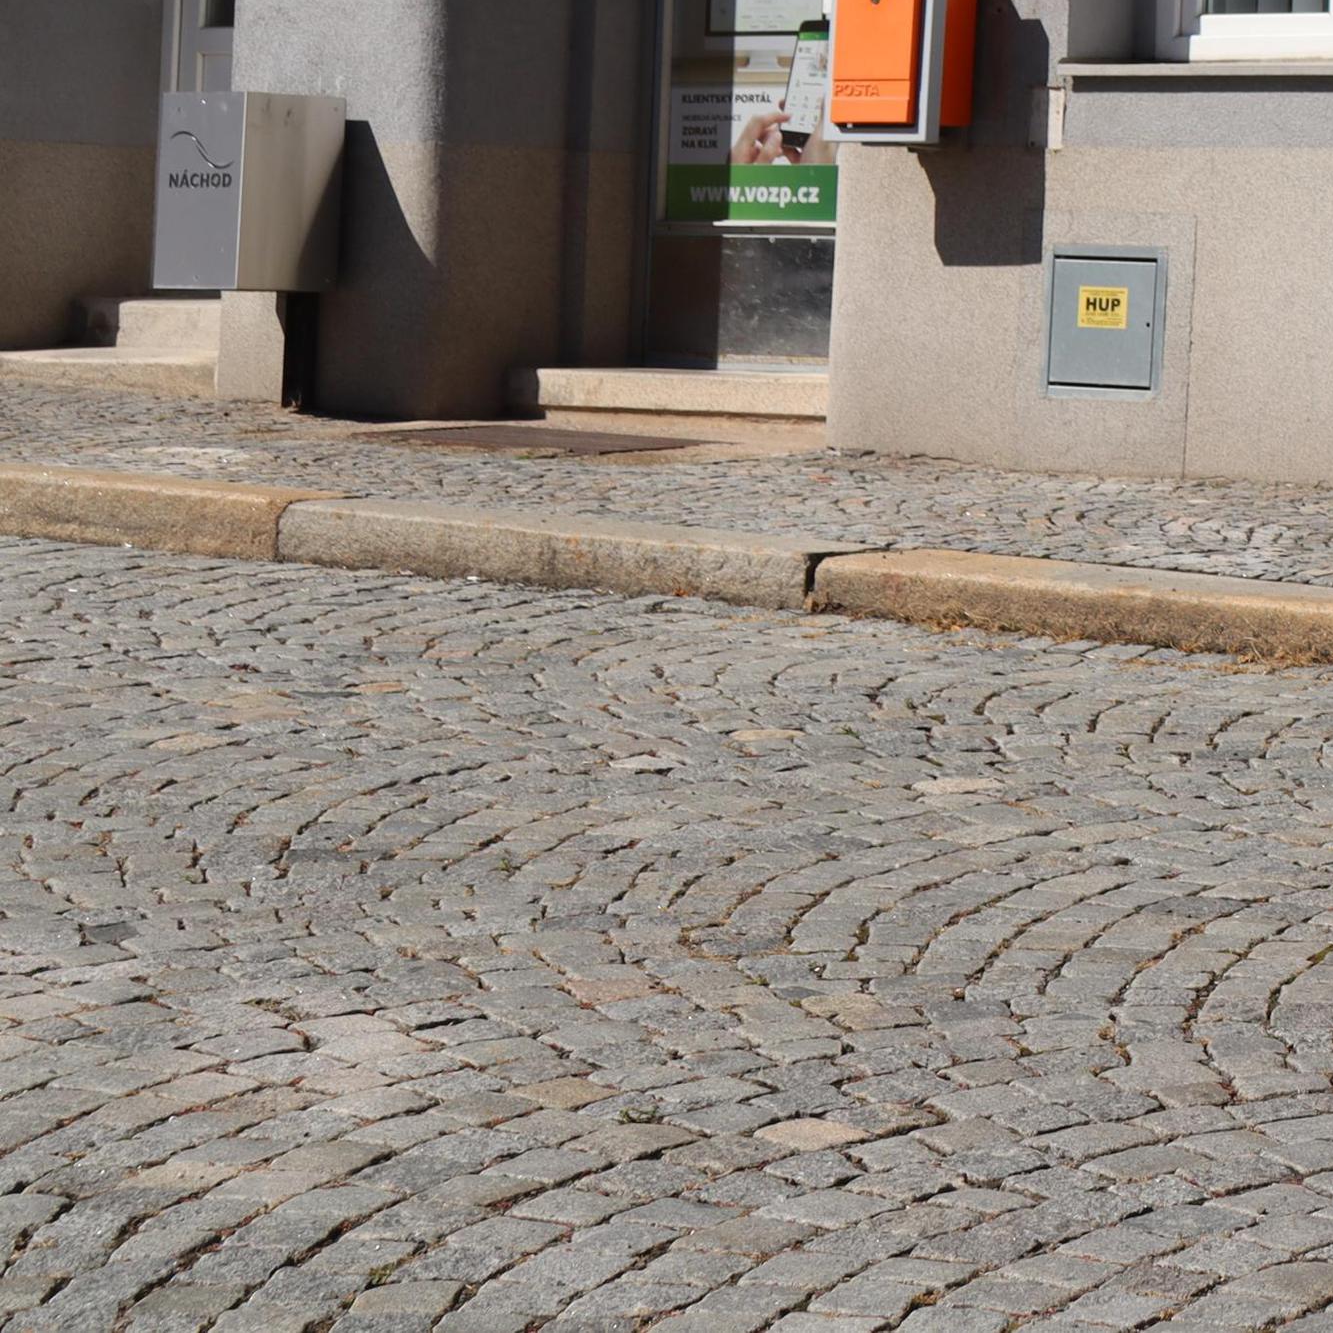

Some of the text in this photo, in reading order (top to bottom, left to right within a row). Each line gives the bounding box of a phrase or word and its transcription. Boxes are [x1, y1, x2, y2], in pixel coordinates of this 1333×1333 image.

[735, 90, 772, 104] PORTÁL
[682, 124, 718, 136] ZDRAVÍ
[681, 139, 718, 149] NA KLIK
[169, 169, 232, 188] NÁCHOD
[690, 185, 820, 208] www.vozp.cz
[1086, 297, 1121, 312] HUP
